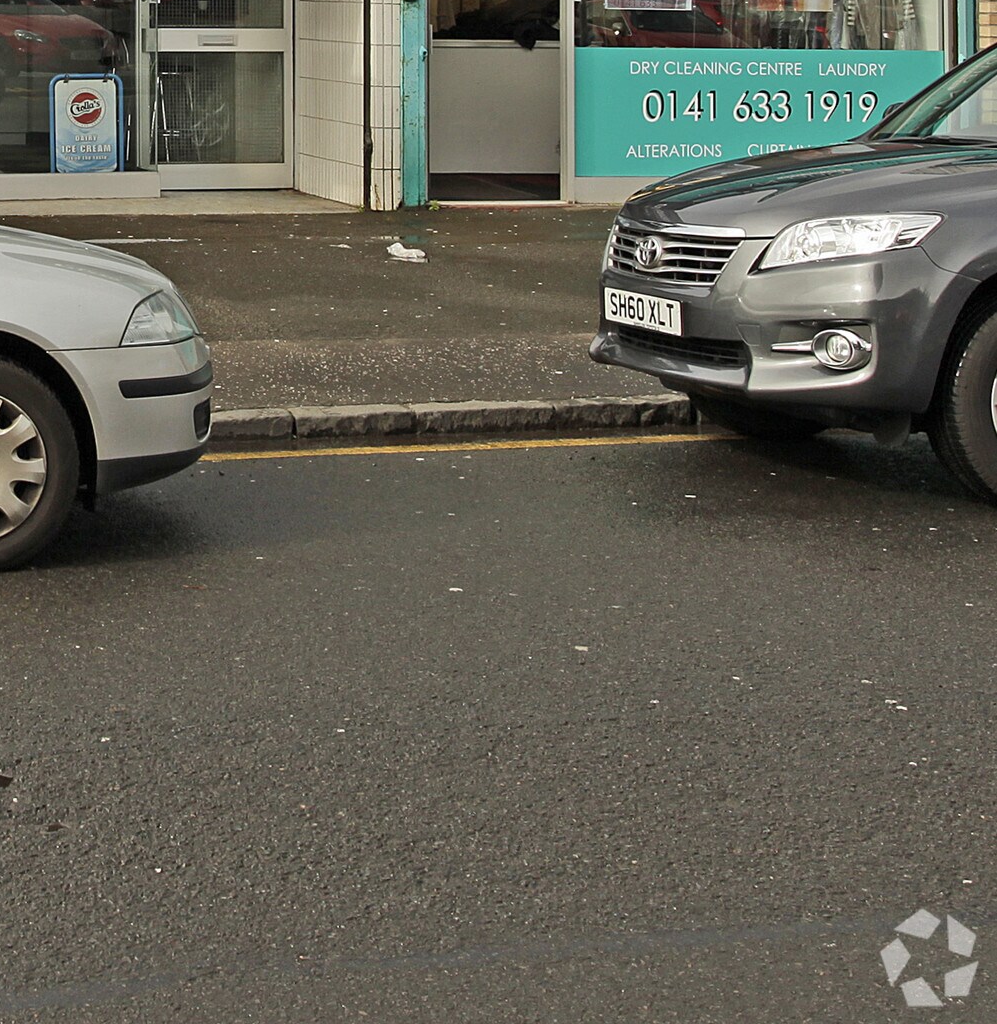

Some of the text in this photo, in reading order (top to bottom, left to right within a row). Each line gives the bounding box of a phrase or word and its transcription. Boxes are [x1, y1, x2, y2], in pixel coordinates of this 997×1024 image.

[630, 61, 887, 77] DRY CLEANING CENTRE LAUNDRY
[642, 89, 878, 123] 0141 633 1919
[61, 144, 112, 154] ICE CREAM
[626, 144, 723, 158] ALTERATIONS
[610, 292, 675, 328] SH60 XLT
